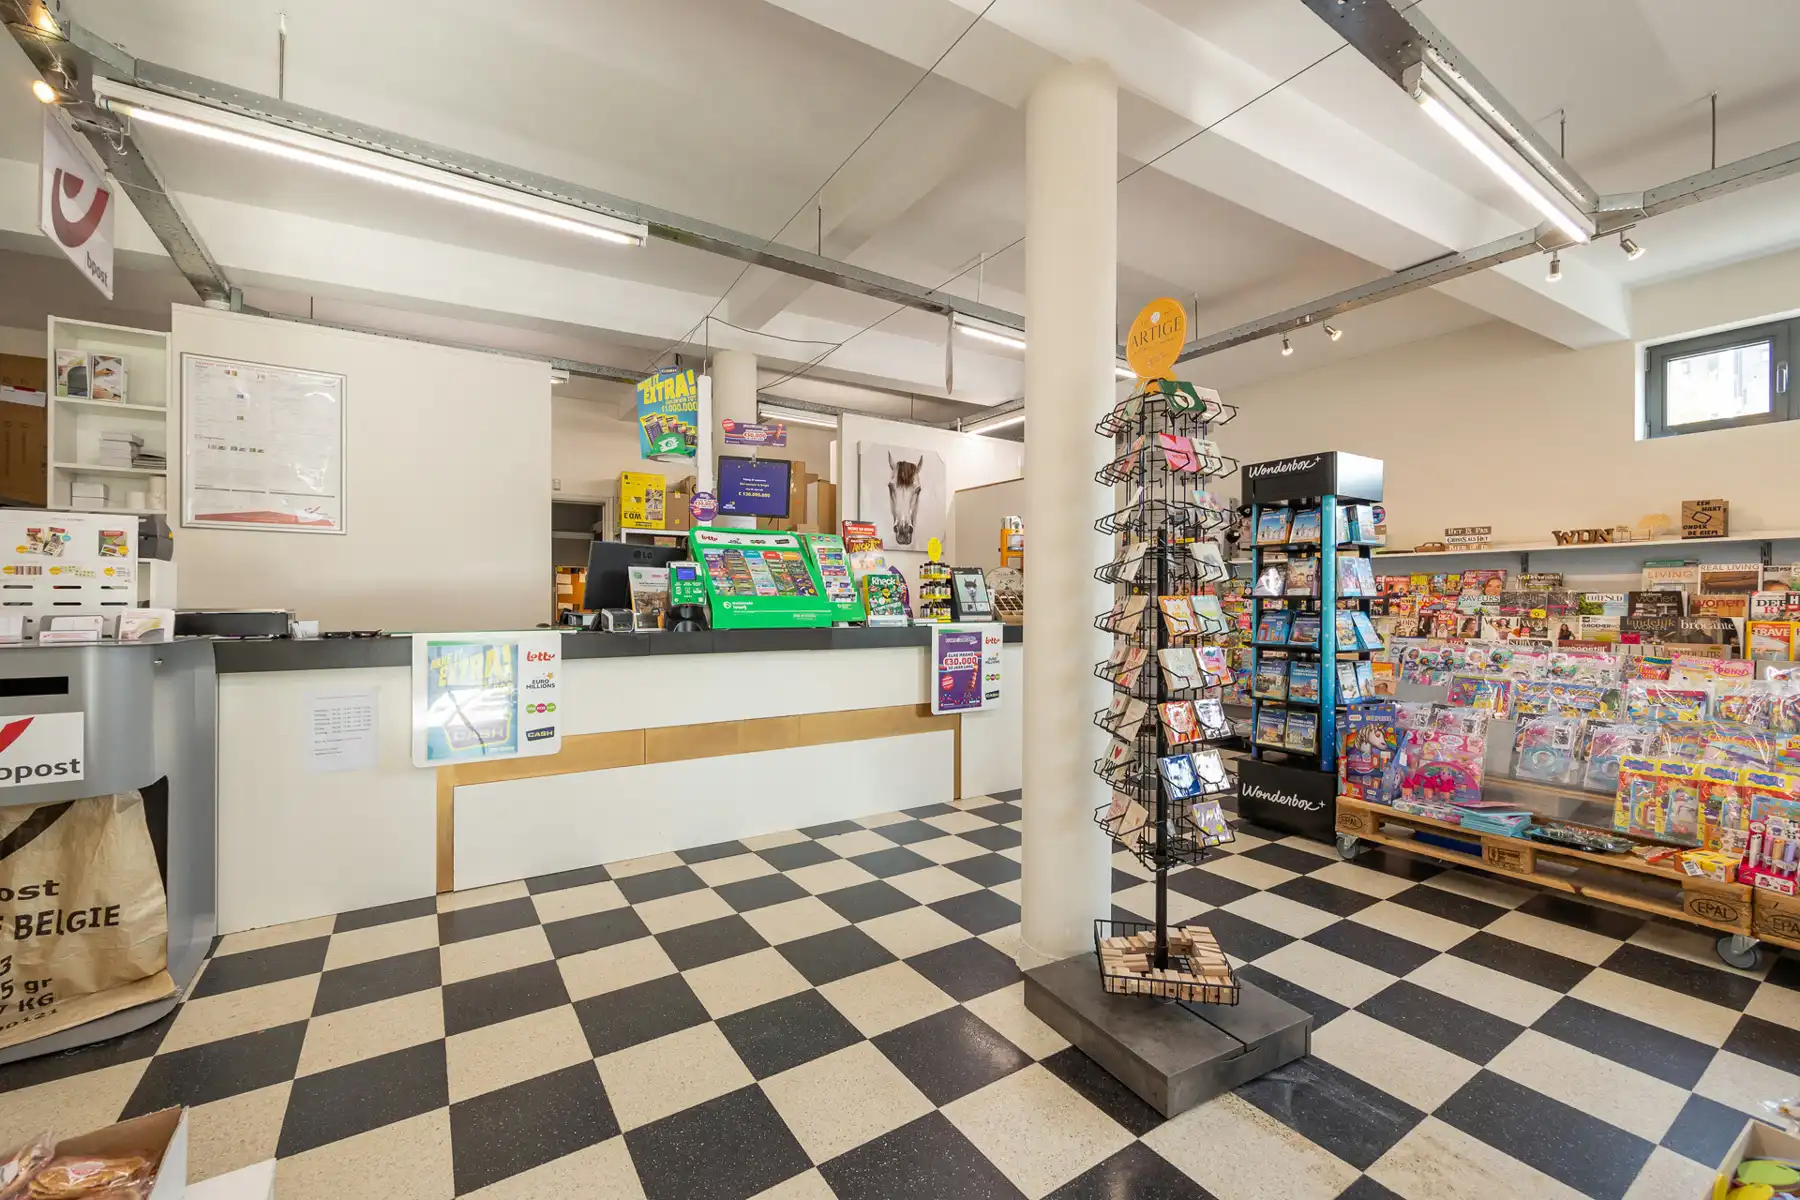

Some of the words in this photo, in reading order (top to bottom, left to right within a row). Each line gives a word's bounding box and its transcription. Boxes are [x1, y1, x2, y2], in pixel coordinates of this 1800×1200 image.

[86, 250, 108, 288] bpost
[1132, 315, 1182, 348] ARTIGE
[1249, 460, 1317, 478] Wonderbox
[1647, 569, 1694, 579] LIVING
[1727, 563, 1760, 571] LIVING
[527, 730, 553, 738] CASH
[1242, 783, 1320, 811] Wonderbox
[1698, 902, 1730, 919] EPAL
[14, 904, 121, 941] BELGIE
